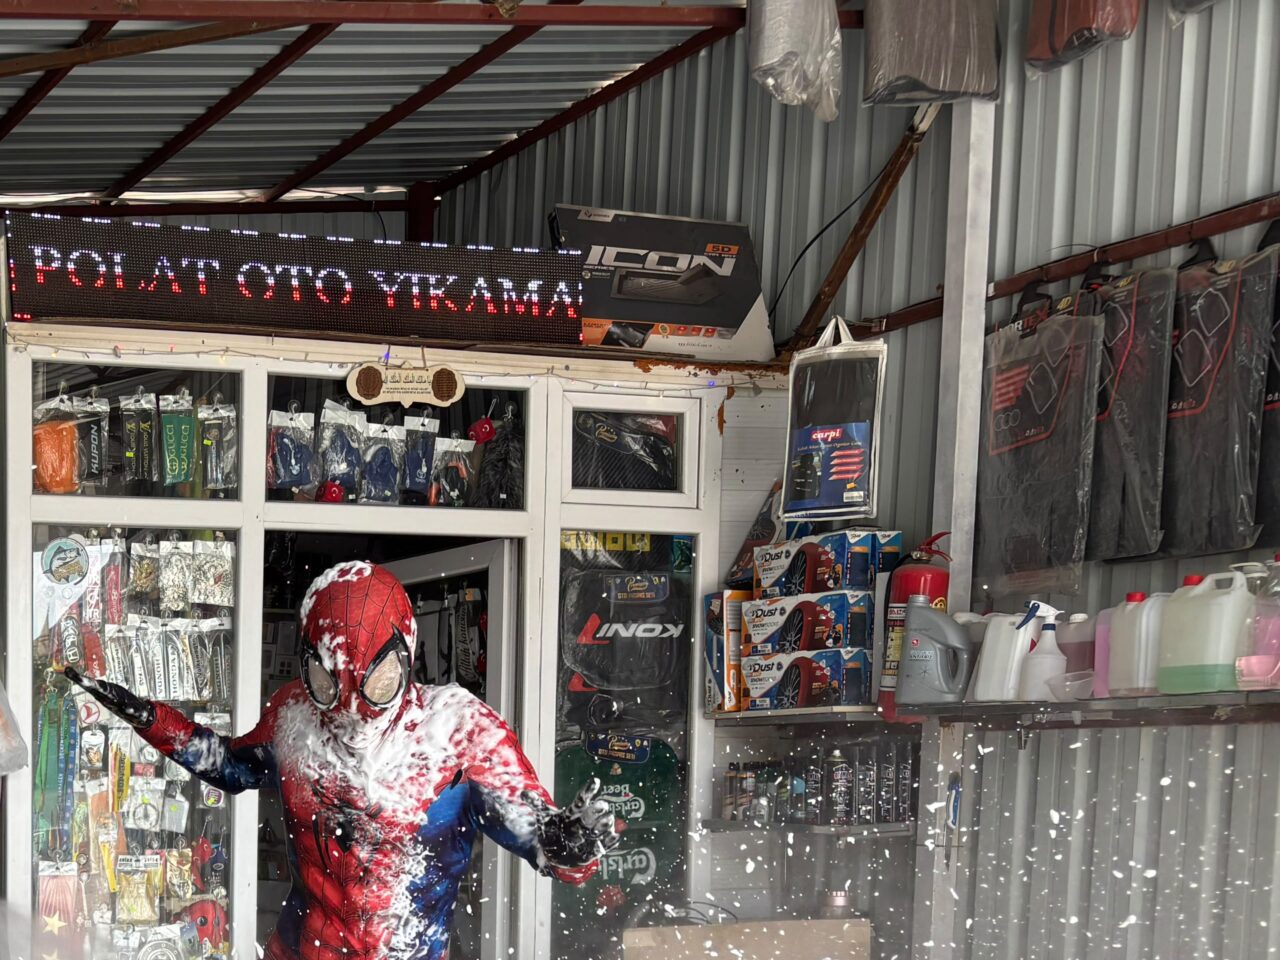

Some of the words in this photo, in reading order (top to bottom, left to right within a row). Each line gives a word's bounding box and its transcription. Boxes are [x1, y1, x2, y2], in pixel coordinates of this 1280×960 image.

[585, 245, 737, 277] ICON
[34, 245, 219, 295] POLAT
[238, 262, 352, 304] OTO
[370, 270, 578, 318] YIKAMA
[166, 424, 175, 456] GUCCI
[181, 424, 190, 456] GUCCI
[812, 428, 840, 442] carpi
[90, 424, 99, 474] KUPON
[765, 550, 783, 562] Dust
[755, 606, 778, 618] Dust
[596, 623, 684, 638] KONI
[155, 659, 163, 695] HONDA
[171, 657, 179, 694] HONDA
[753, 662, 775, 673] Dust
[601, 784, 630, 797] Beer
[607, 796, 646, 819] Carlsb
